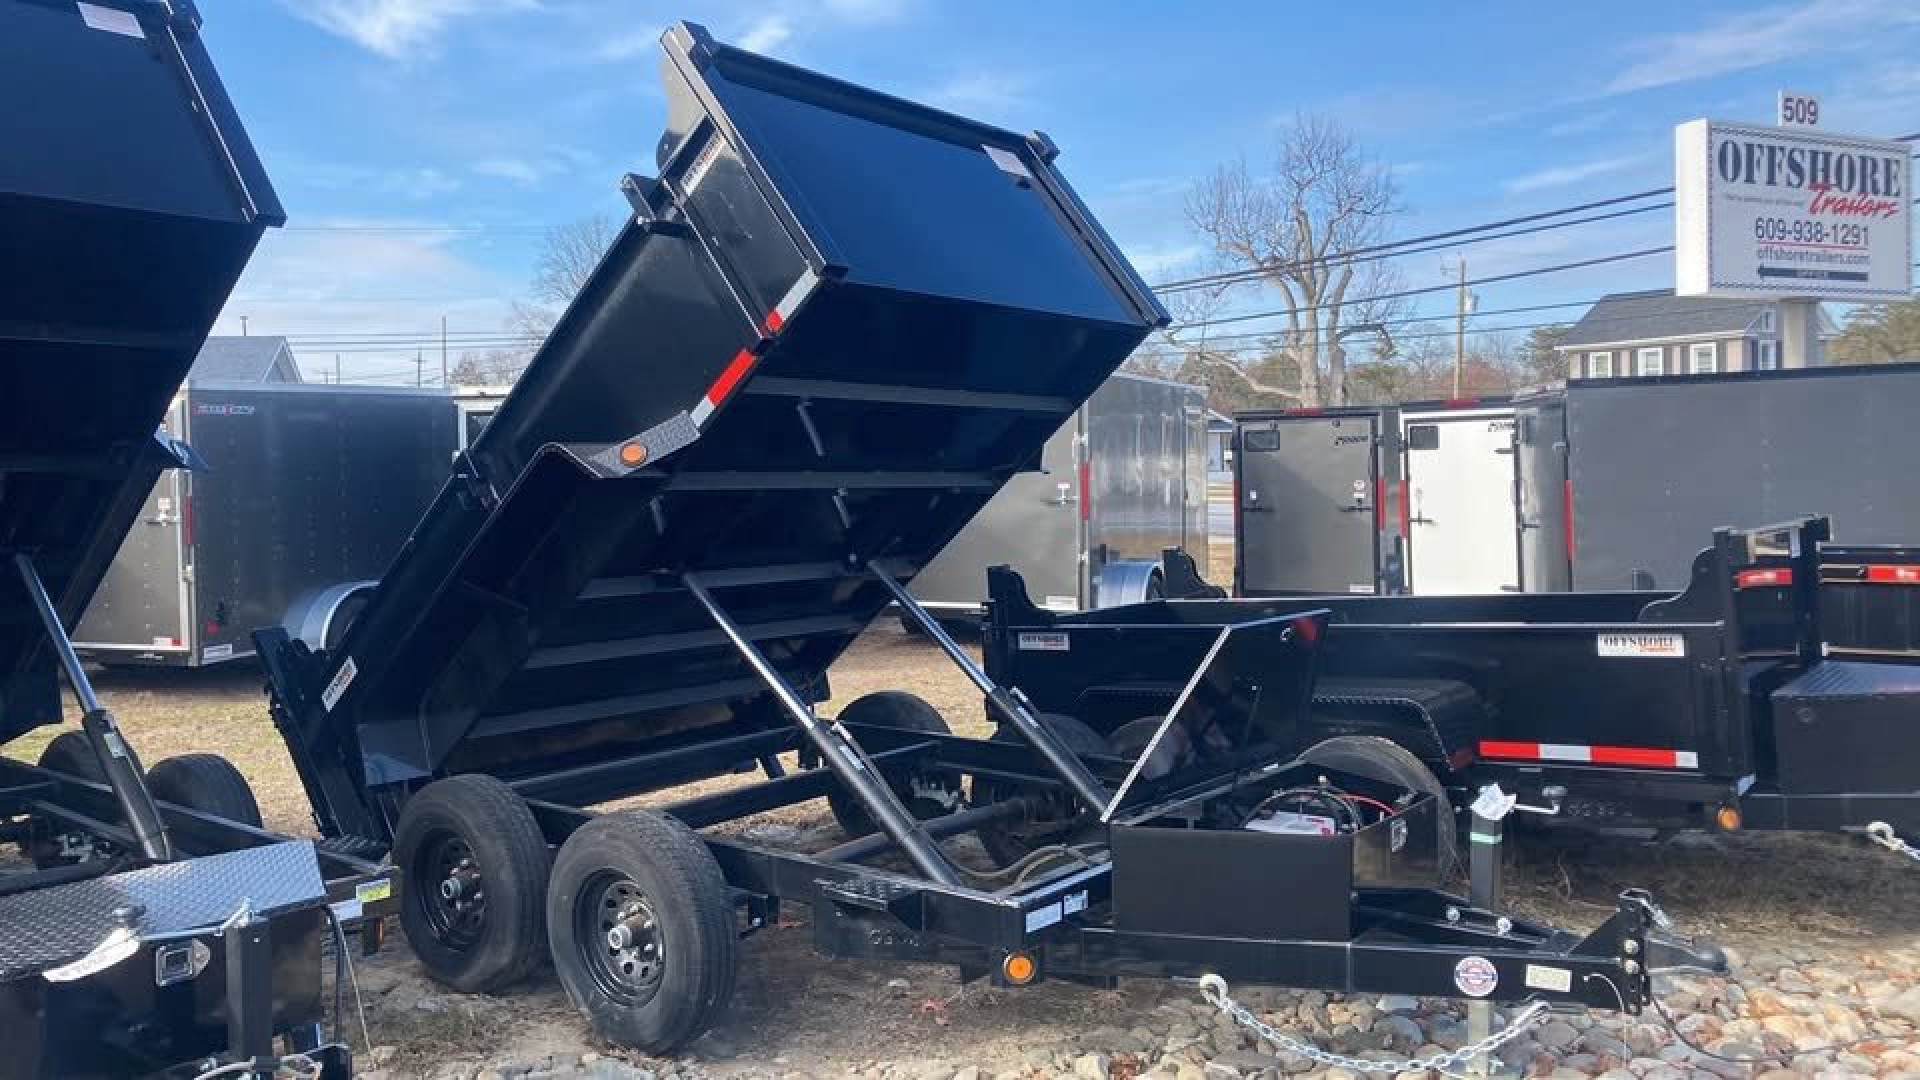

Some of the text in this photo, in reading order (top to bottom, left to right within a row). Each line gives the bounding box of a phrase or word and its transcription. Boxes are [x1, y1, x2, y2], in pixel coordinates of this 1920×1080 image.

[1783, 97, 1818, 125] 509
[1718, 139, 1901, 197] OFFSHORE
[1755, 217, 1868, 245] 609-938-1291
[1757, 246, 1870, 265] offshoretrailers.com
